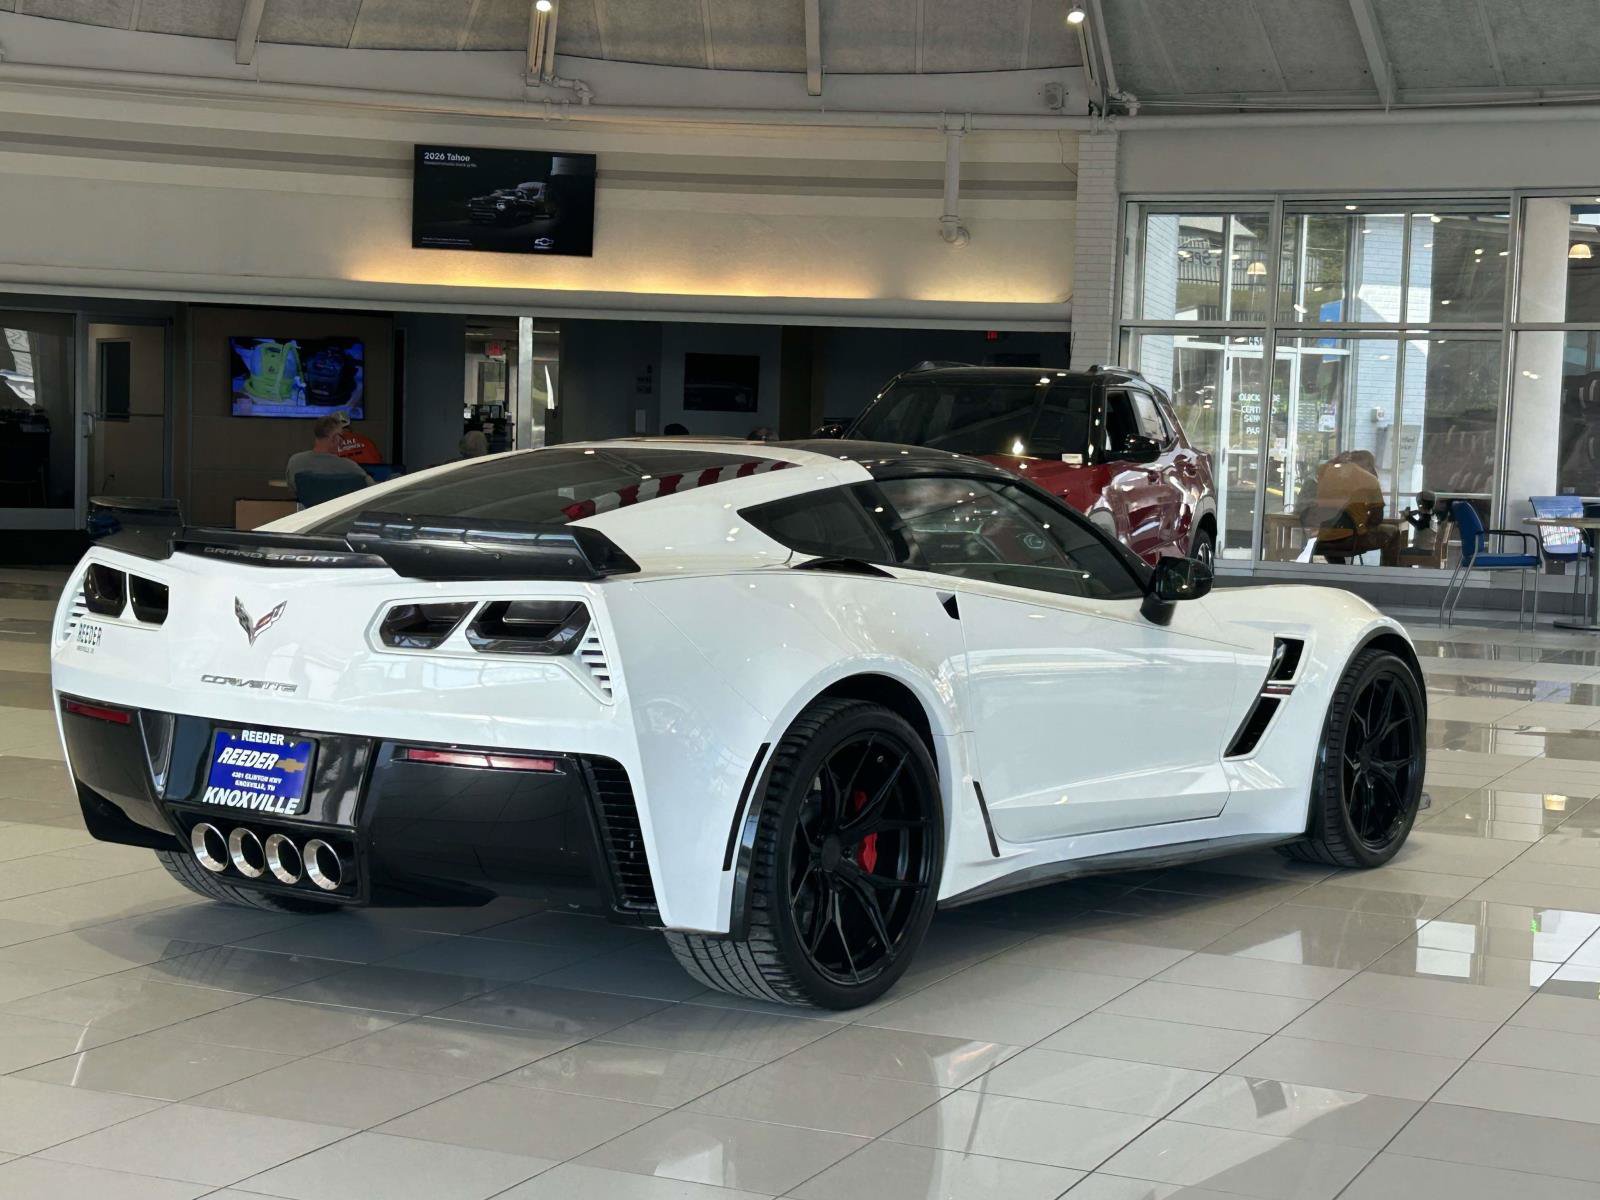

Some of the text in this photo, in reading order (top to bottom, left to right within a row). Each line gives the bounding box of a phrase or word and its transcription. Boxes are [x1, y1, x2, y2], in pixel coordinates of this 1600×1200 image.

[424, 152, 471, 162] 2026 Tahoe
[204, 547, 345, 563] GRAND SPORT
[201, 674, 298, 692] CORVETTE
[241, 729, 285, 746] REEDER
[217, 747, 279, 770] REEDER
[202, 786, 300, 815] KNOXVILLE
